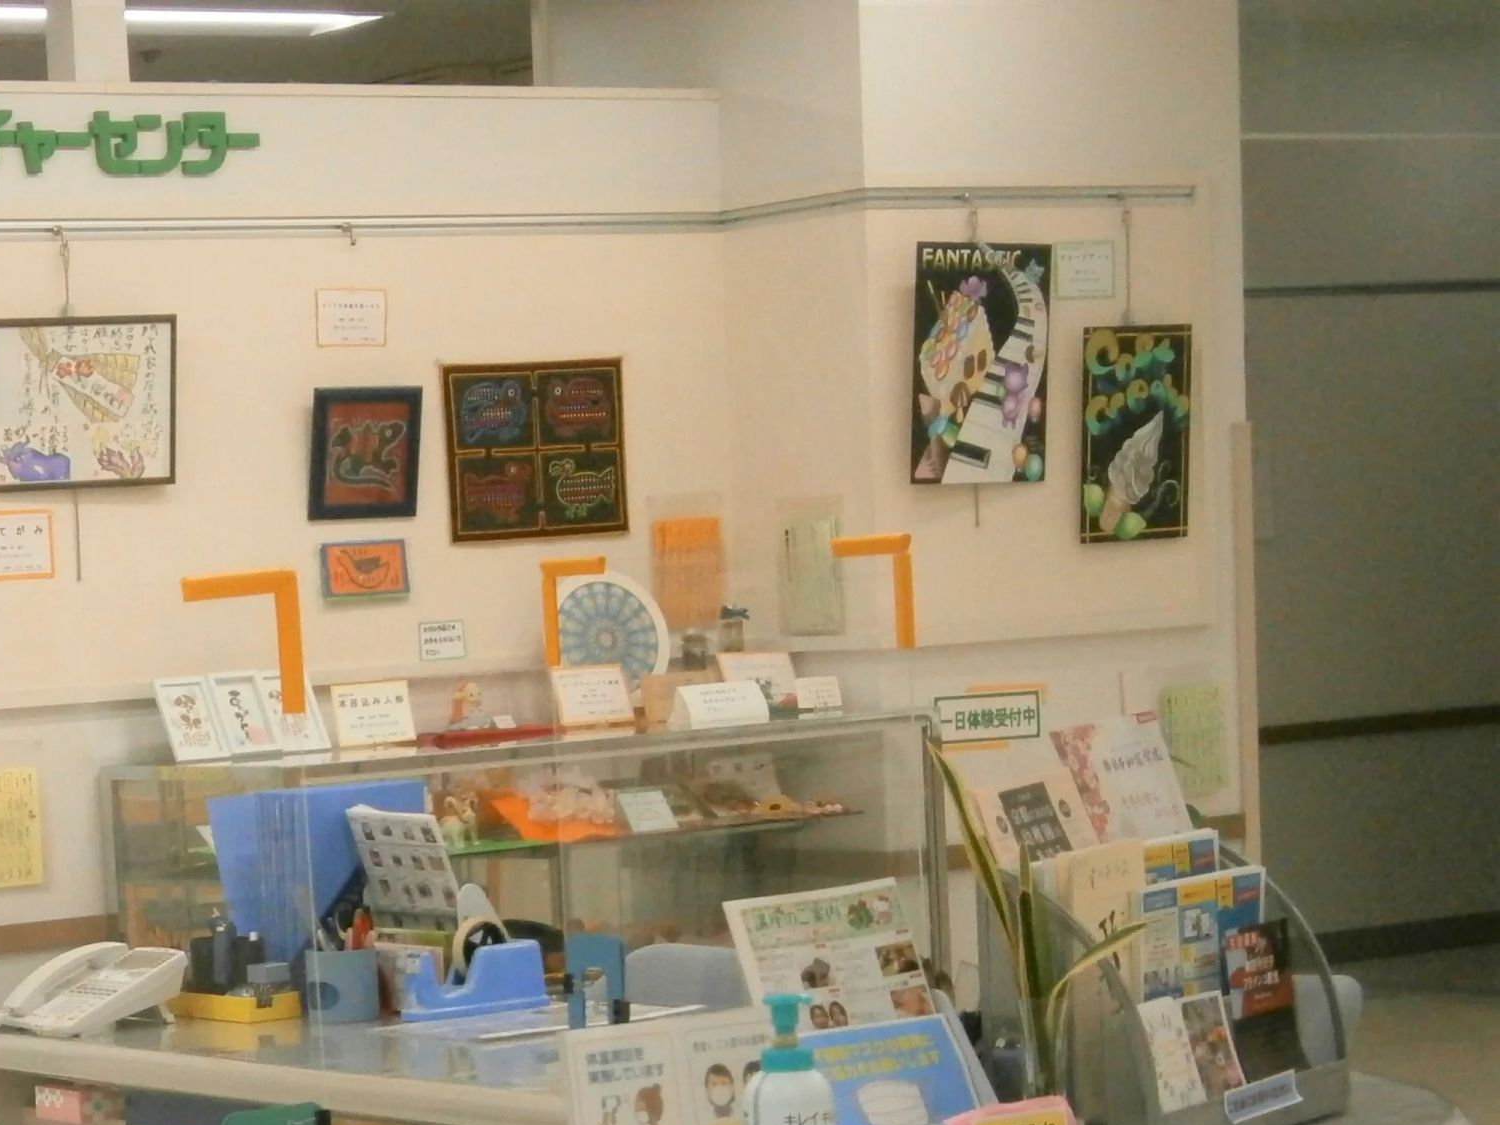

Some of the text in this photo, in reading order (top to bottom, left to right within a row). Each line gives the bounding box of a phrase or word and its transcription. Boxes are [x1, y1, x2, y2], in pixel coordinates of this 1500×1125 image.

[922, 247, 1022, 271] FANTASTIC
[338, 695, 405, 709] 木目込み人形
[940, 705, 1036, 732] 一日体験受付中
